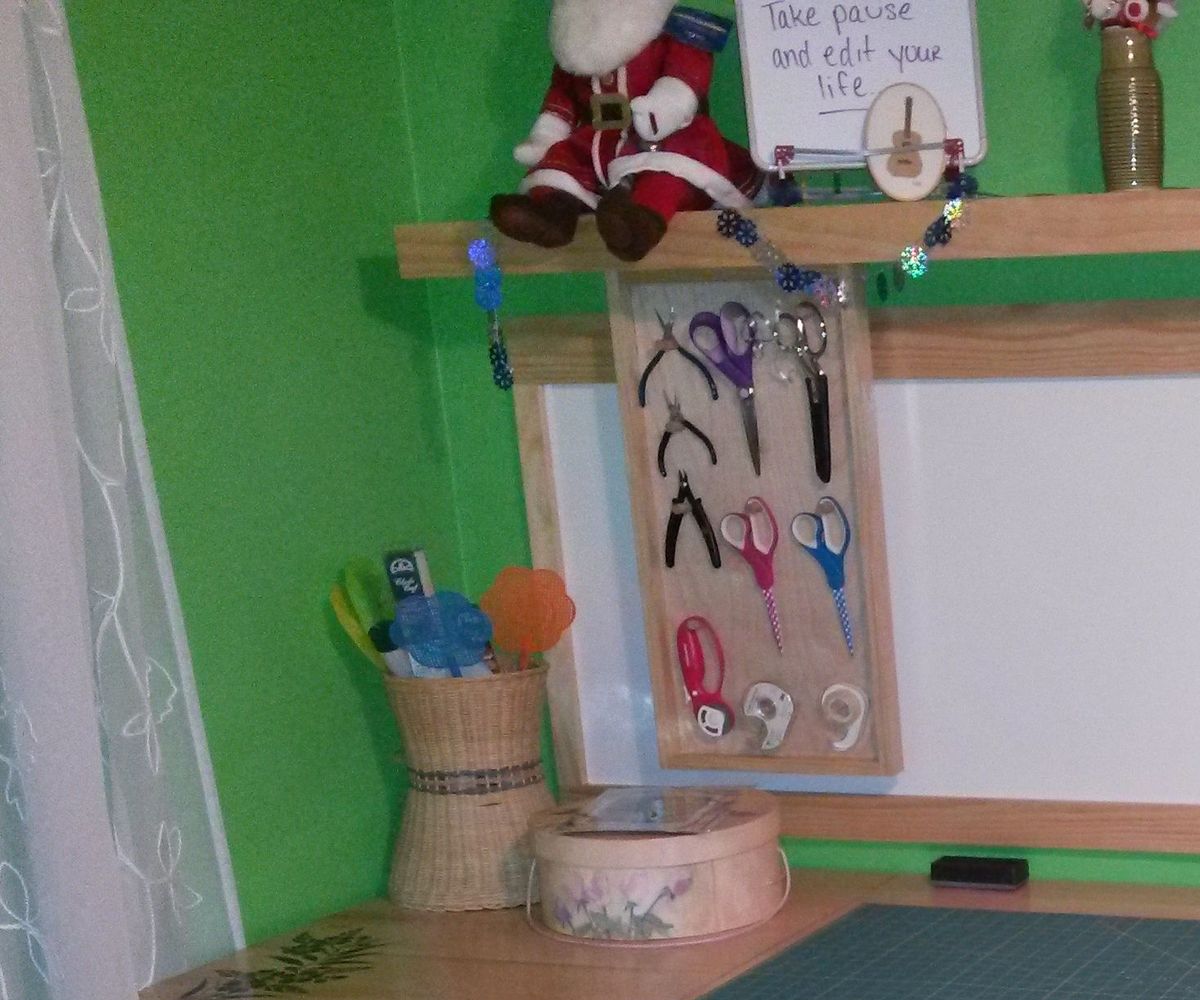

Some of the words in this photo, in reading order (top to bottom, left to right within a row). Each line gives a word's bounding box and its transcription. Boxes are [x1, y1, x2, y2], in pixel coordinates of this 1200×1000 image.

[761, 1, 821, 30] Take
[832, 2, 914, 35] pause
[773, 40, 811, 68] and
[823, 35, 874, 68] edit
